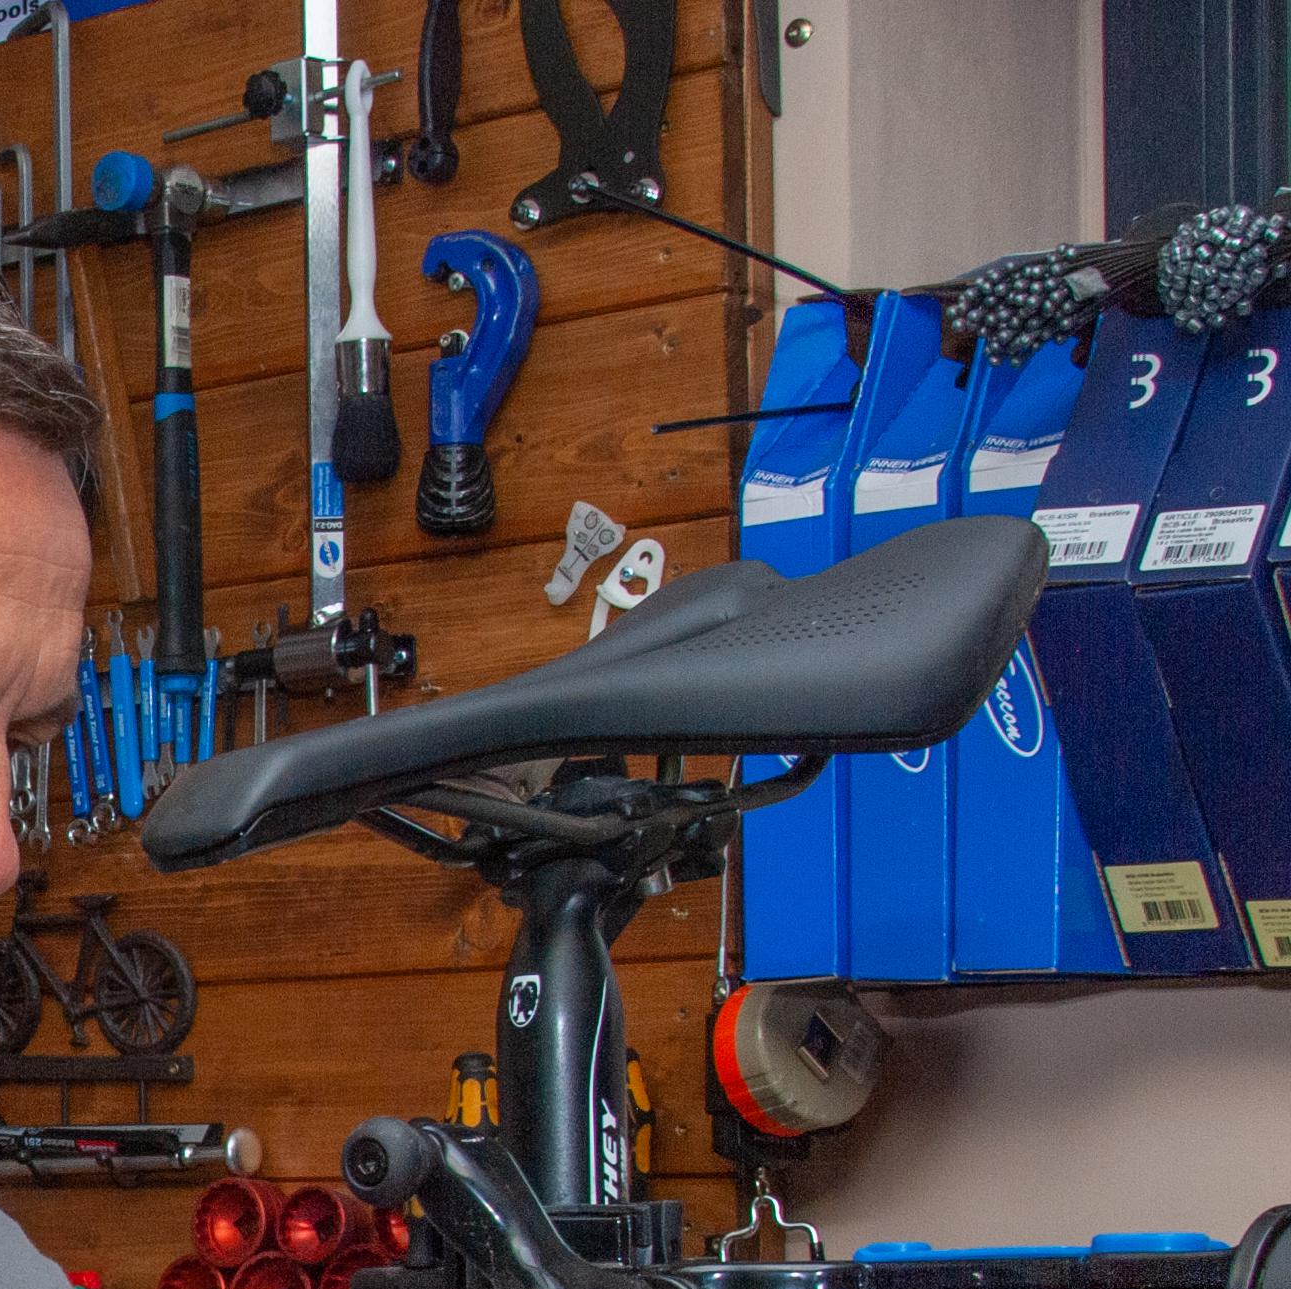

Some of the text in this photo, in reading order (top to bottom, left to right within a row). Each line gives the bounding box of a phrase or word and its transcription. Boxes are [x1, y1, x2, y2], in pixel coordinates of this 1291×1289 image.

[1129, 354, 1162, 409] 3
[1246, 349, 1279, 407] 3
[984, 435, 1027, 449] INNER
[868, 457, 913, 470] INNER
